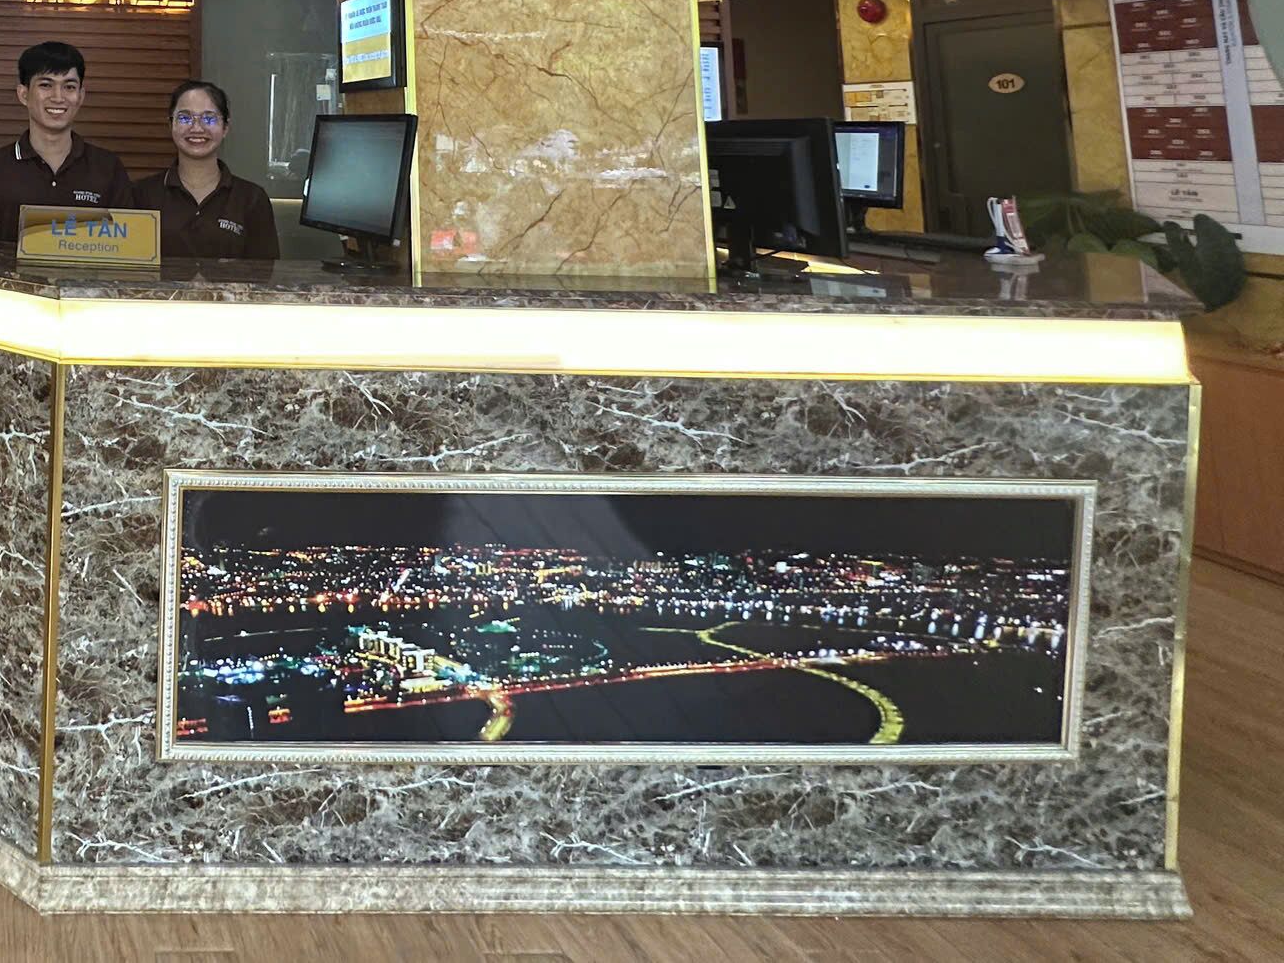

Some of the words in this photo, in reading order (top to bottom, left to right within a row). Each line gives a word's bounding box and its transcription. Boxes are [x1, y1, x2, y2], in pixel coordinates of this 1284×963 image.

[996, 78, 1015, 90] 101
[75, 193, 99, 204] HOTEL
[51, 214, 77, 237] LỄ
[86, 217, 127, 238] TÂN
[58, 239, 119, 253] Reception
